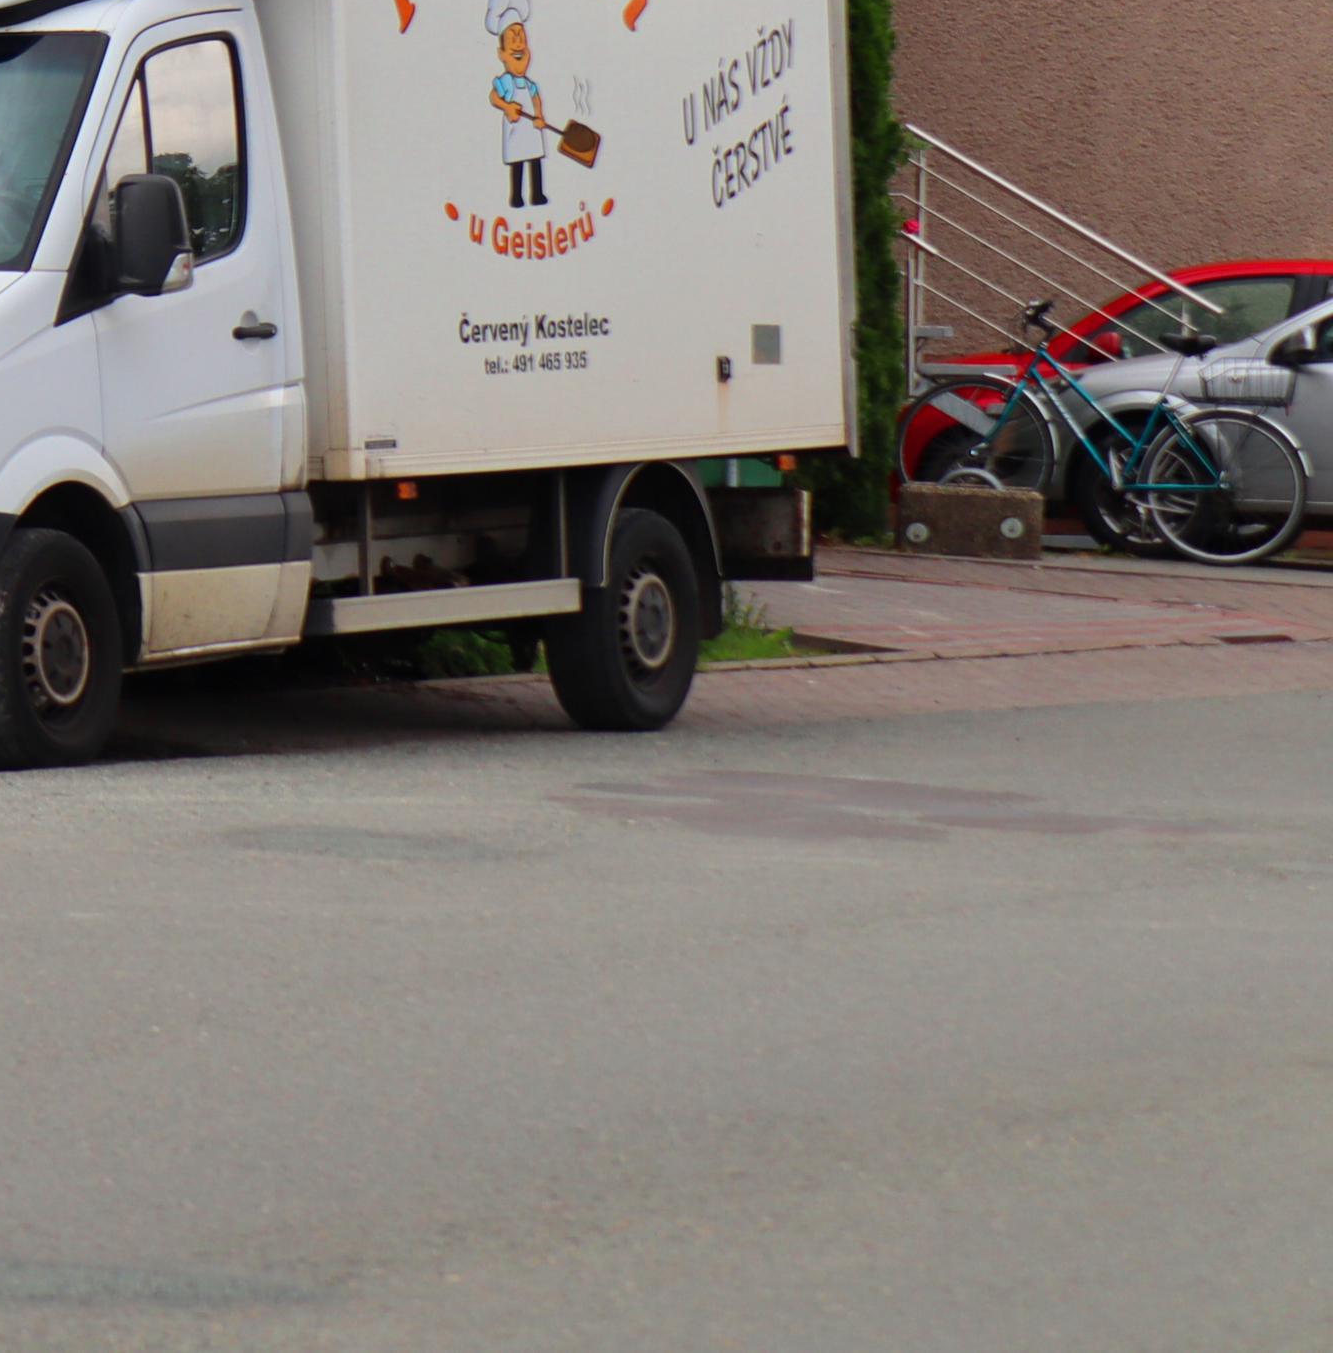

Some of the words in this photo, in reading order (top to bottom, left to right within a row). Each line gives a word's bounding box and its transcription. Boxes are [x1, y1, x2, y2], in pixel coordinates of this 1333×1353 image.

[683, 93, 695, 146] U
[703, 57, 741, 132] NÁS
[746, 18, 793, 96] VŽDY
[712, 94, 793, 209] ČERSTVÉ
[469, 214, 485, 245] u
[490, 200, 596, 261] Geislerů
[459, 313, 529, 347] Červený
[535, 313, 610, 340] Kostelec
[485, 356, 509, 375] tel.:
[512, 354, 533, 373] 491
[538, 353, 562, 371] 465
[564, 351, 588, 370] 935
